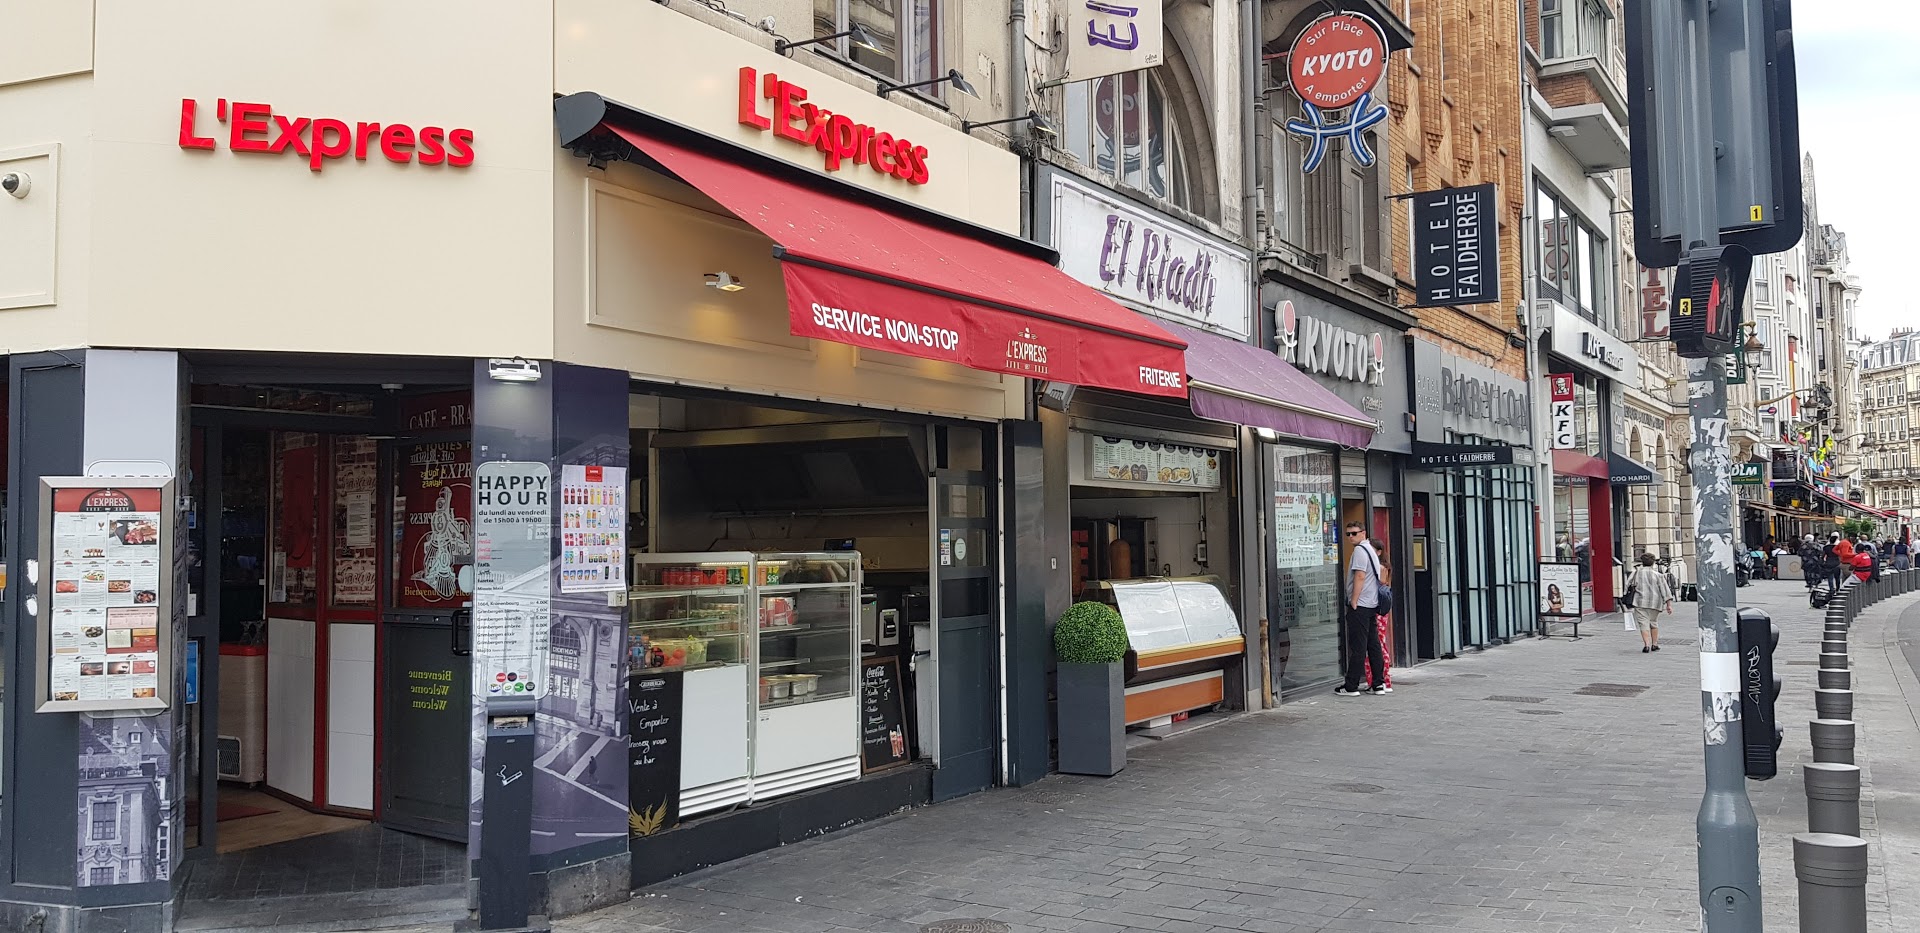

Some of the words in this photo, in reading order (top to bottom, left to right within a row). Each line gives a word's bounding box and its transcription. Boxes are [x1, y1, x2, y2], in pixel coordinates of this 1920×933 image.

[1306, 26, 1327, 46] Sur
[1332, 21, 1364, 37] Place
[1302, 47, 1373, 77] KYOTO
[1304, 84, 1315, 94] A
[1315, 76, 1368, 104] emporter
[179, 97, 475, 172] L'Express
[739, 66, 930, 185] L'Express
[1753, 208, 1759, 219] 1
[1430, 195, 1451, 300] HOTEL
[1456, 191, 1479, 298] FAIDHERBE
[1100, 214, 1134, 288] El
[1137, 228, 1217, 317] Riadh
[1641, 266, 1669, 337] TEL
[1682, 302, 1689, 313] 3
[811, 303, 883, 338] SERVICE
[885, 318, 959, 351] NON-STOP
[1006, 339, 1048, 363] L'EXPRESS
[1300, 315, 1368, 382] KYOTO
[1139, 366, 1182, 388] FRITERIE
[1441, 366, 1529, 432] BABYLON
[409, 409, 437, 429] CAFE
[450, 404, 471, 426] BRA
[1555, 404, 1571, 445] KFC
[1421, 455, 1457, 464] HOTEL
[1460, 452, 1495, 463] FAIDHERBE
[1731, 464, 1758, 476] DLM
[423, 462, 471, 480] L'EXPR
[478, 475, 548, 490] HAPPY
[87, 497, 129, 507] L'EXPRESS
[478, 491, 548, 506] HOUR
[1275, 494, 1294, 506] mporter
[404, 586, 436, 596] Bienvenu
[629, 699, 650, 713] Vente
[652, 699, 658, 710] à
[640, 714, 669, 733] Emporter
